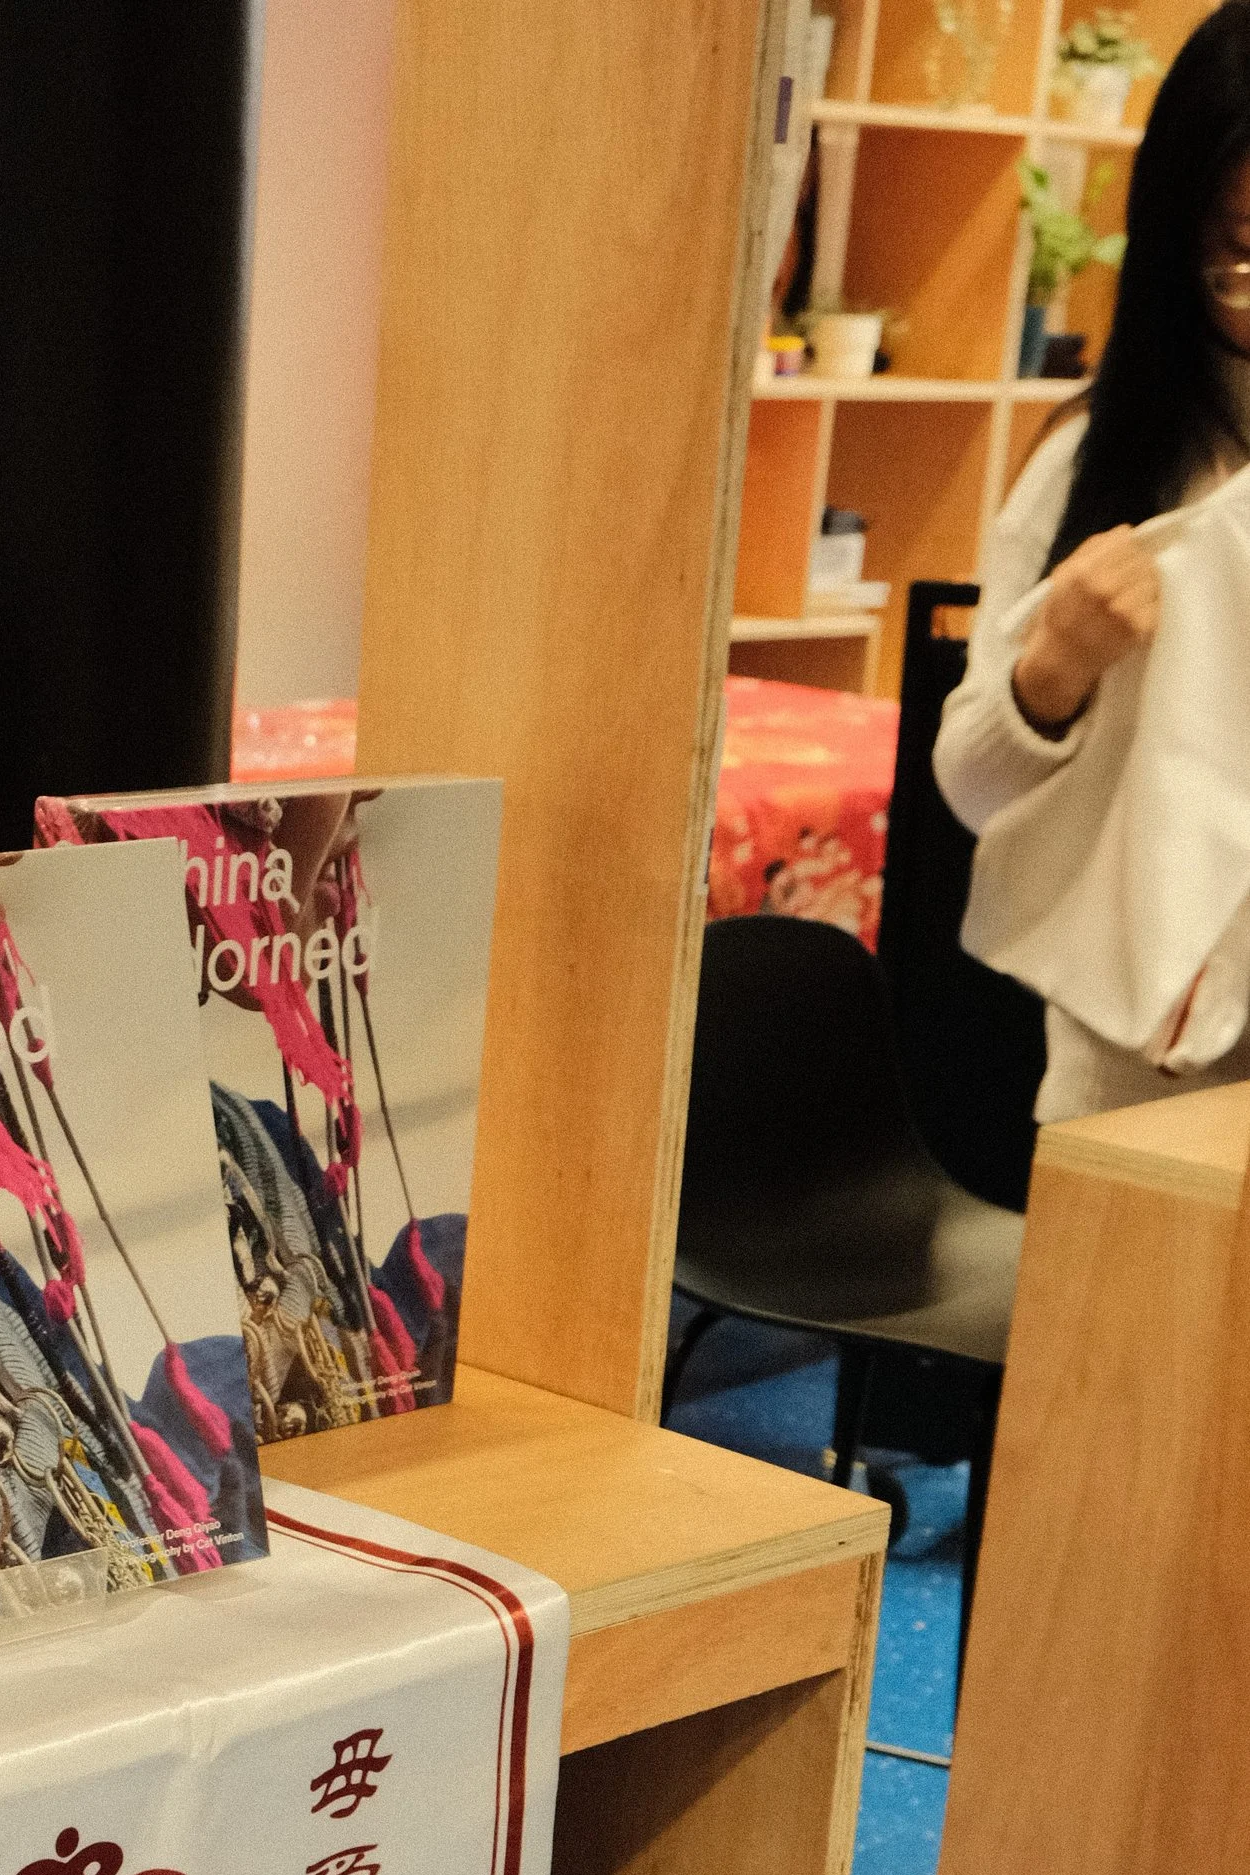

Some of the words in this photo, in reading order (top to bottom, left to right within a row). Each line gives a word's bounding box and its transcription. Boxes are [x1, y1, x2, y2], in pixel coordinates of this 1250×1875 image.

[179, 836, 293, 906] hina
[191, 906, 378, 992] orned
[166, 1527, 192, 1540] Deng
[193, 1521, 221, 1535] Qiyao
[183, 1542, 195, 1554] by
[196, 1539, 212, 1550] Cat
[214, 1532, 245, 1546] Vinton
